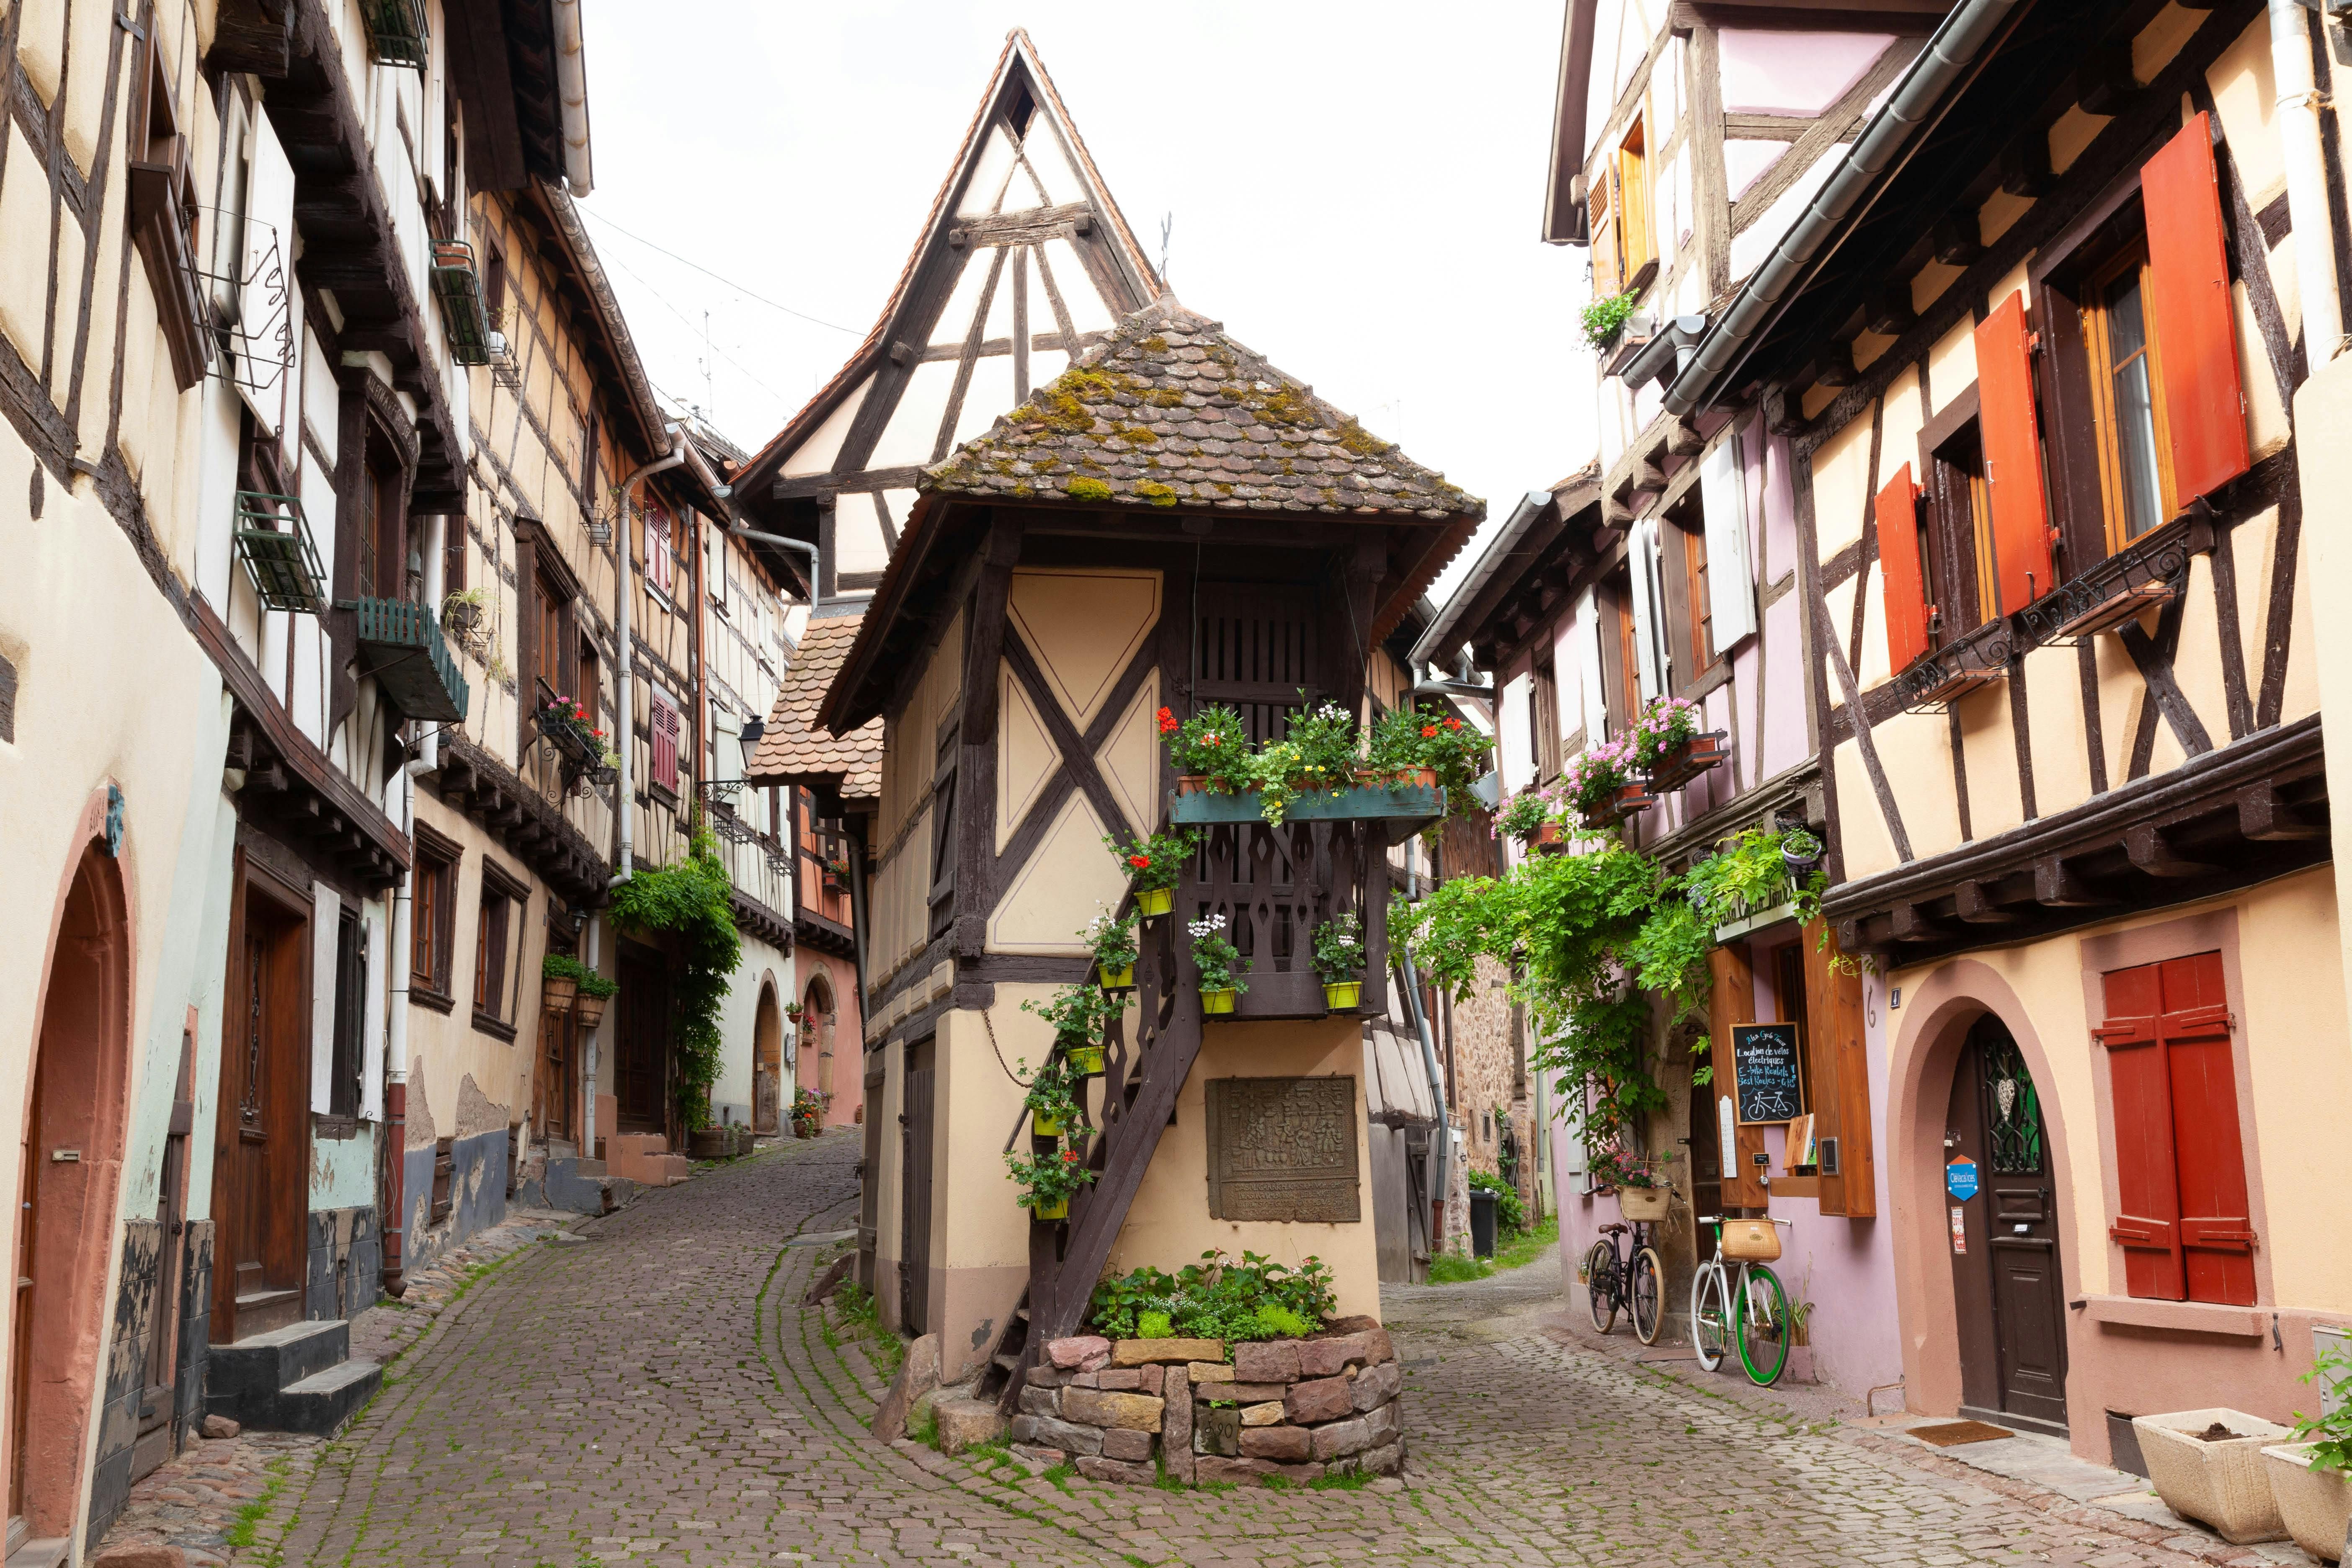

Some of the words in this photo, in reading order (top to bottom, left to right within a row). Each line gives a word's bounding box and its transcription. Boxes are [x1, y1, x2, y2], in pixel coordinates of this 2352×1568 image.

[1893, 991, 1897, 1005] 4
[1746, 1034, 1759, 1044] Alsa
[1760, 1030, 1773, 1040] Cyclo
[1737, 1046, 1764, 1057] Location
[1765, 1044, 1774, 1055] de
[1748, 1055, 1784, 1067] électriques
[1764, 1065, 1789, 1077] Rentals
[1738, 1075, 1754, 1087] Best
[1754, 1075, 1775, 1086] Routes
[1953, 1217, 1963, 1226] 2016
